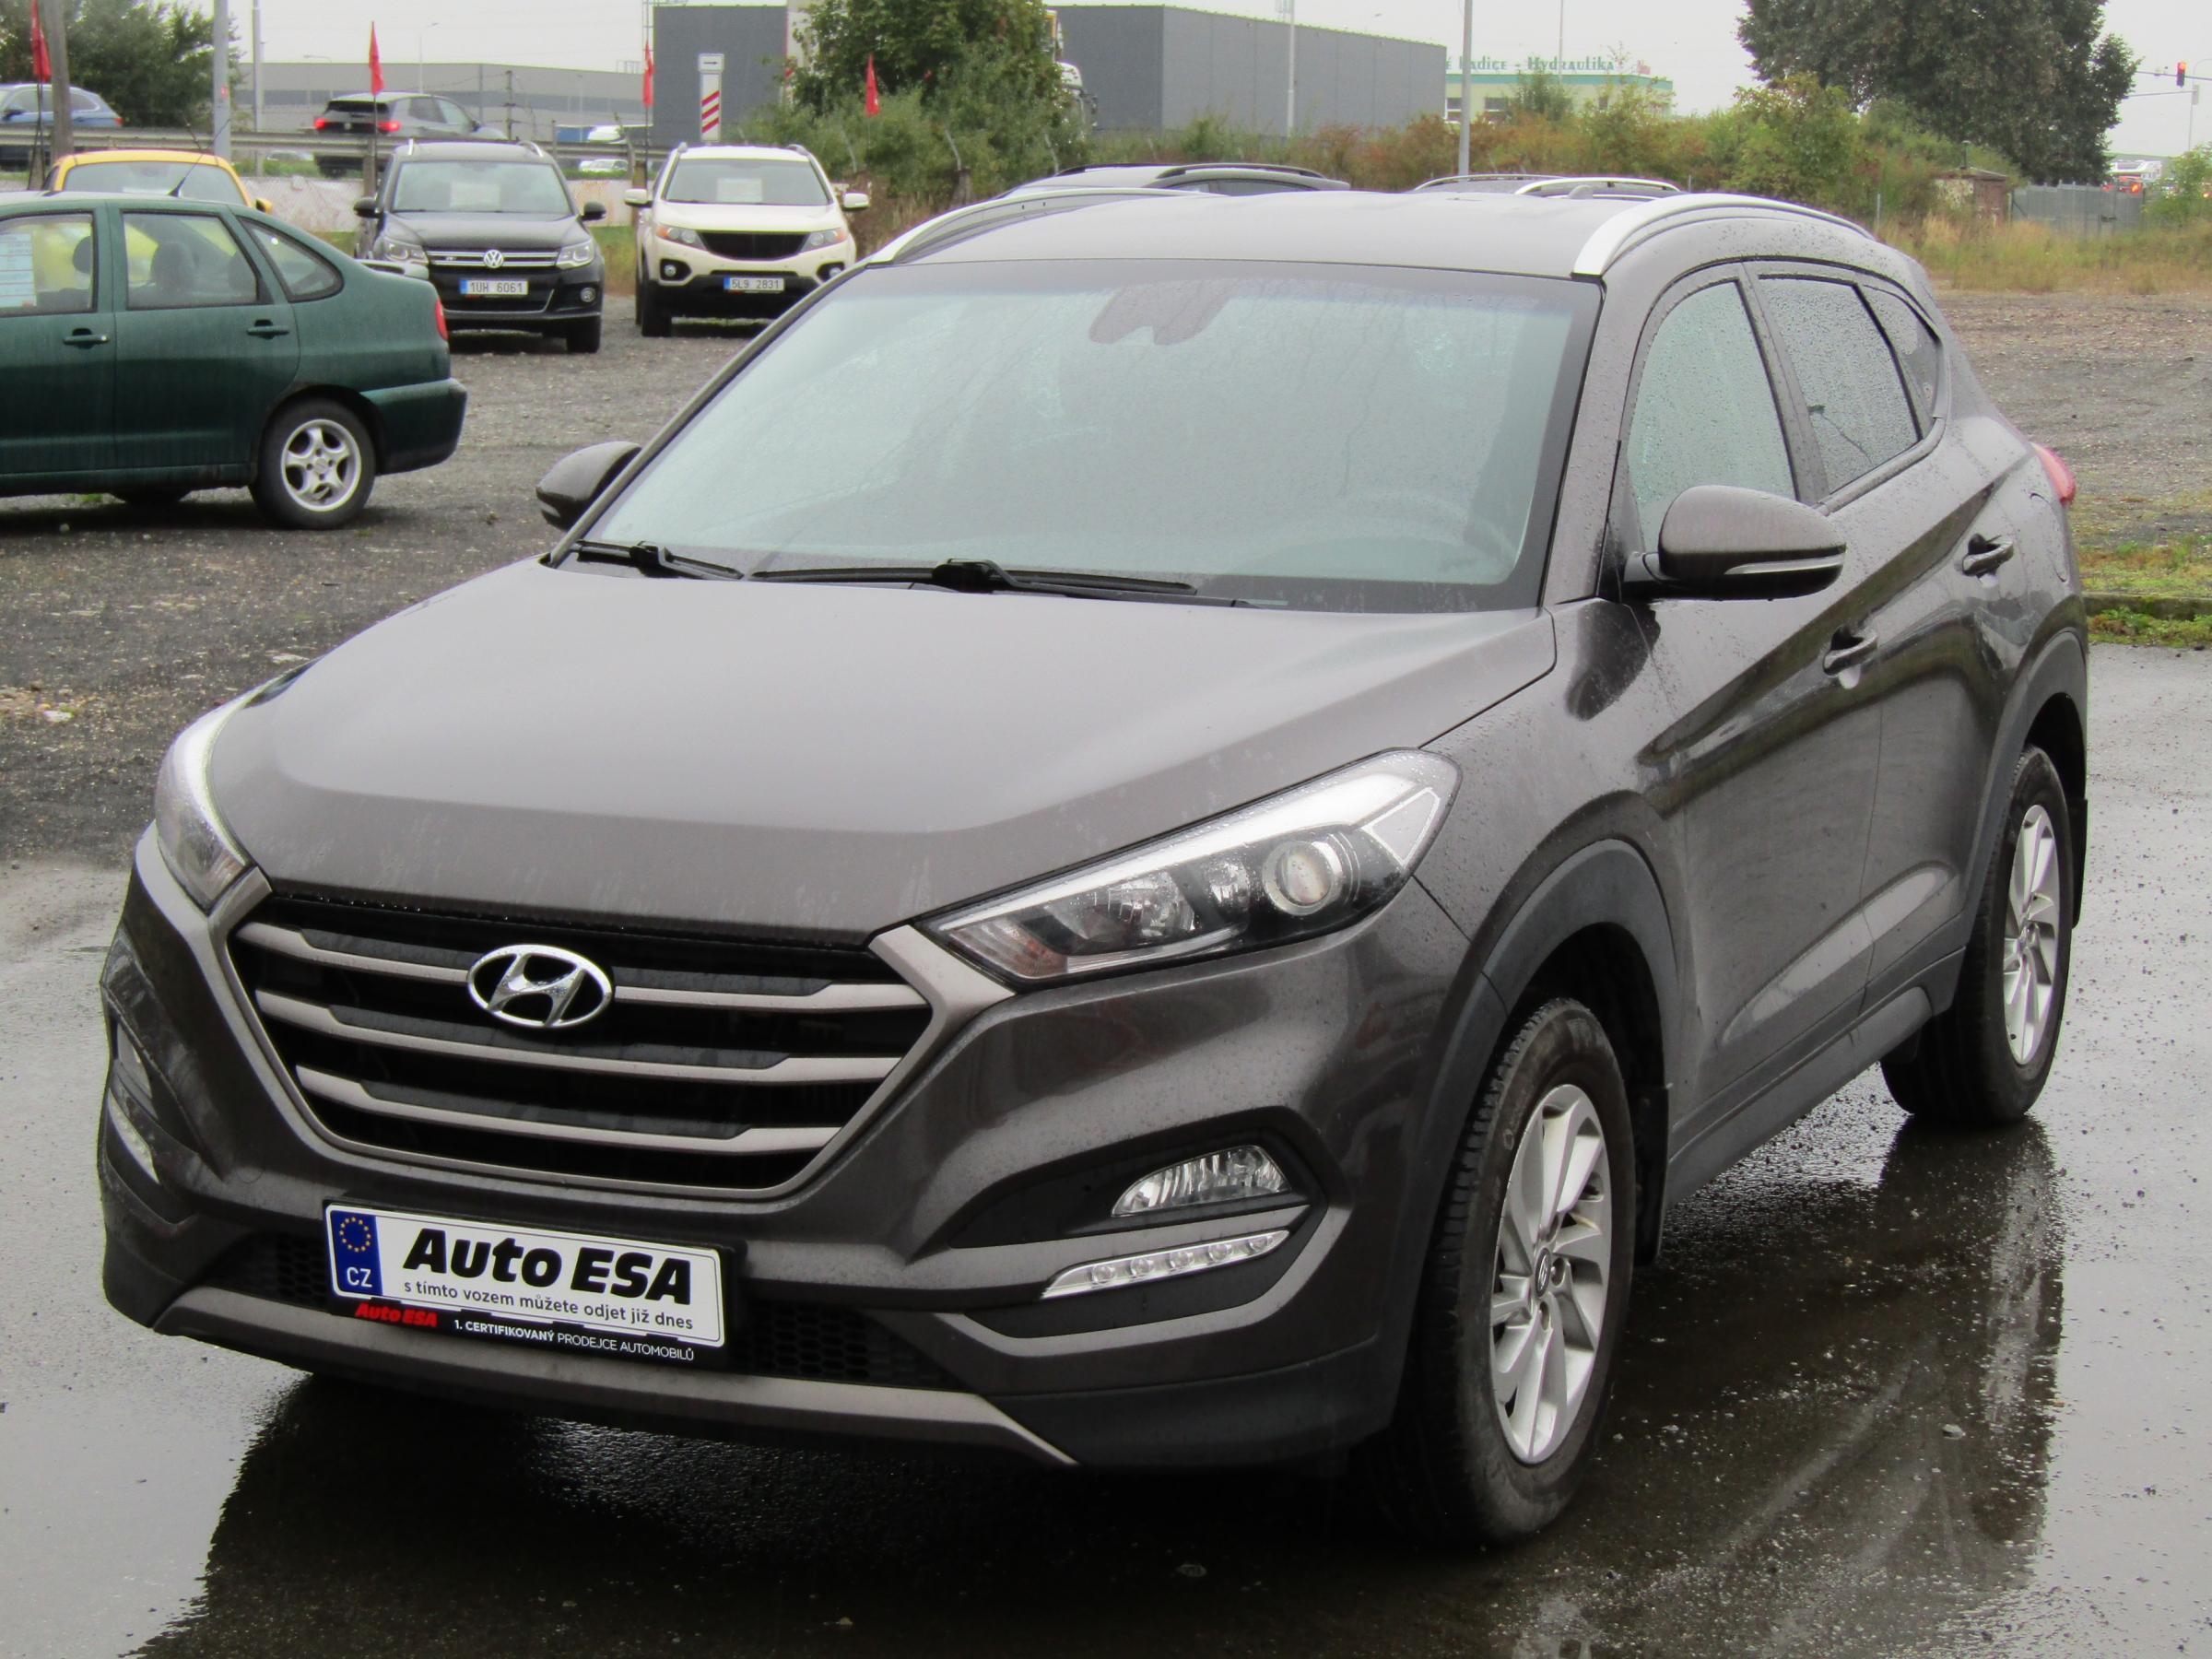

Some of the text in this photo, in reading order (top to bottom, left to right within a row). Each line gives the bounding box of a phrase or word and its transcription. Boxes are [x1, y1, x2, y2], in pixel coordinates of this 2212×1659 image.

[470, 281, 523, 293] 1UH 6061
[731, 278, 780, 289] 5L9 2831
[347, 1266, 372, 1288] CZ
[403, 1228, 690, 1305] Auto ESA
[355, 1301, 438, 1327] Auto ESA
[404, 1280, 693, 1329] s tímto vozem můžete odjet již dnes
[454, 1319, 694, 1360] 1. CERTIFIKOVANÝ PRODEJCE AUTOMOBILŮ
